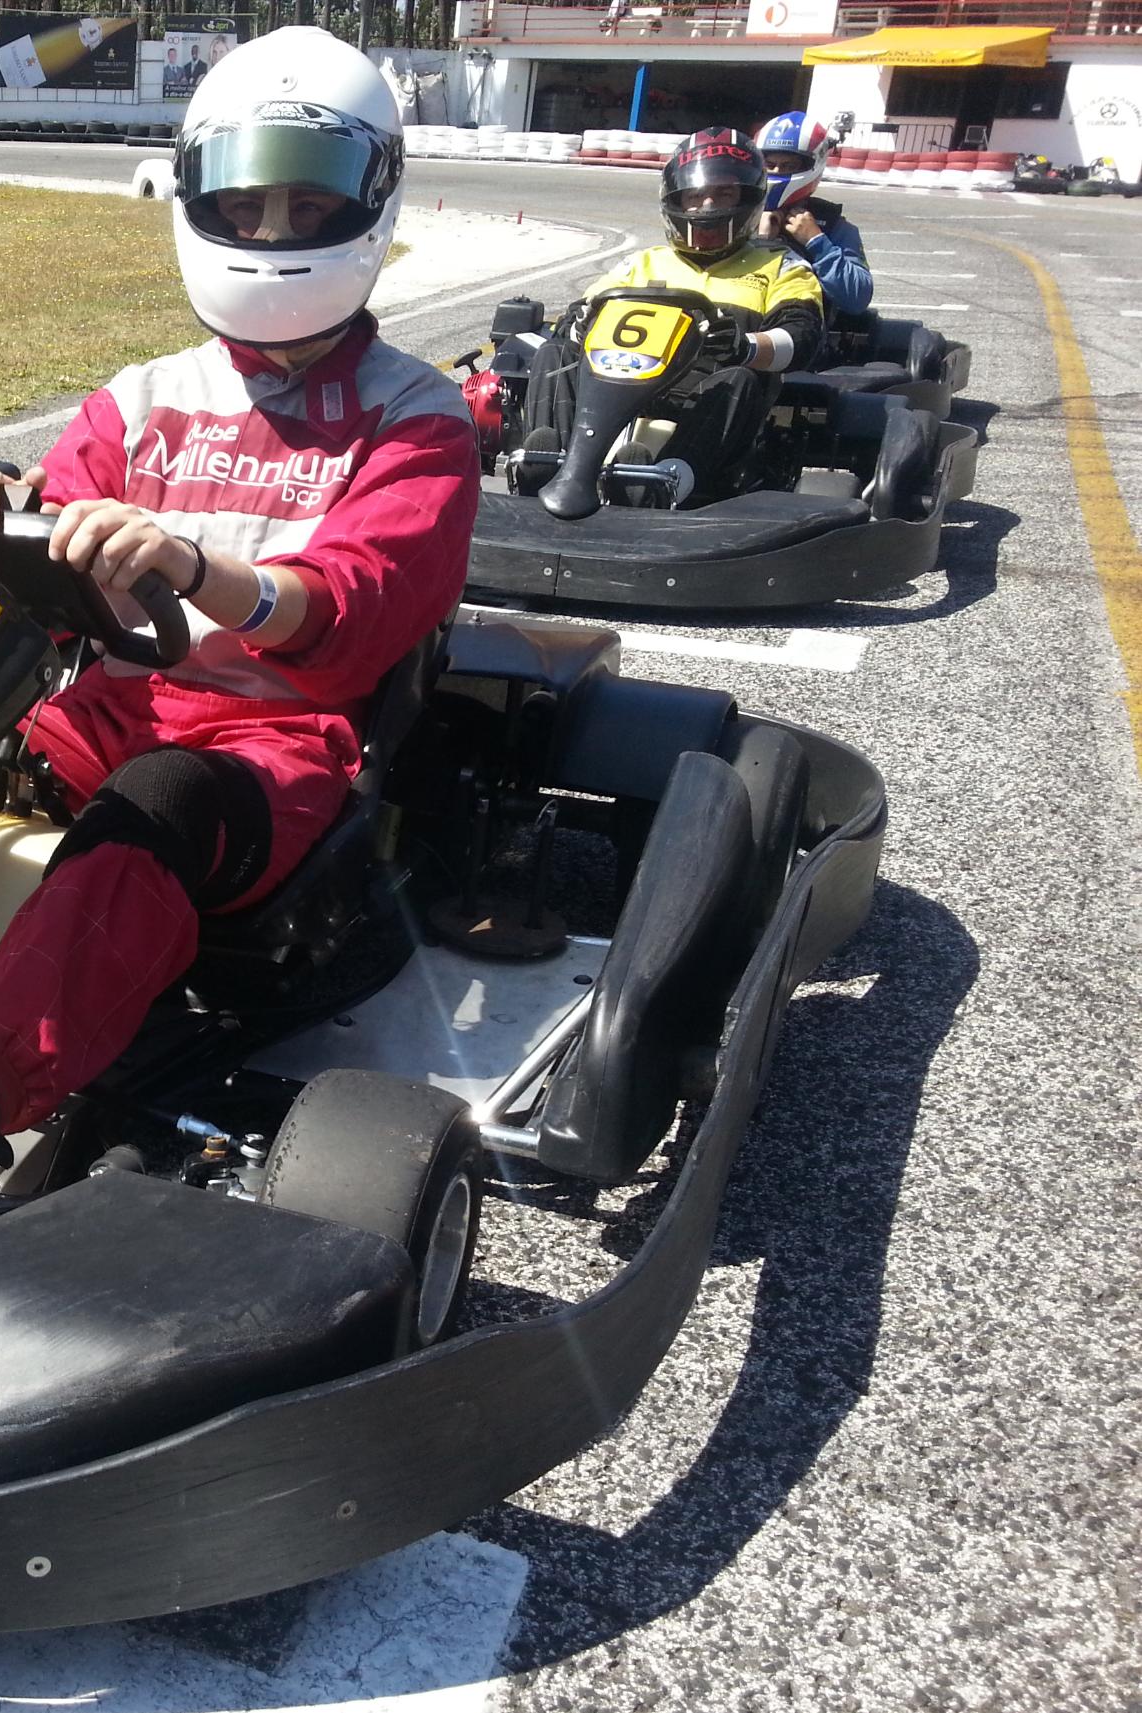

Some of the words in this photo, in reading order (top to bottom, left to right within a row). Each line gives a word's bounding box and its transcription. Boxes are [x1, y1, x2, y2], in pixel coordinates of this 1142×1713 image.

[612, 309, 657, 348] 6
[144, 428, 354, 483] Millennium
[281, 483, 322, 510] bcp
